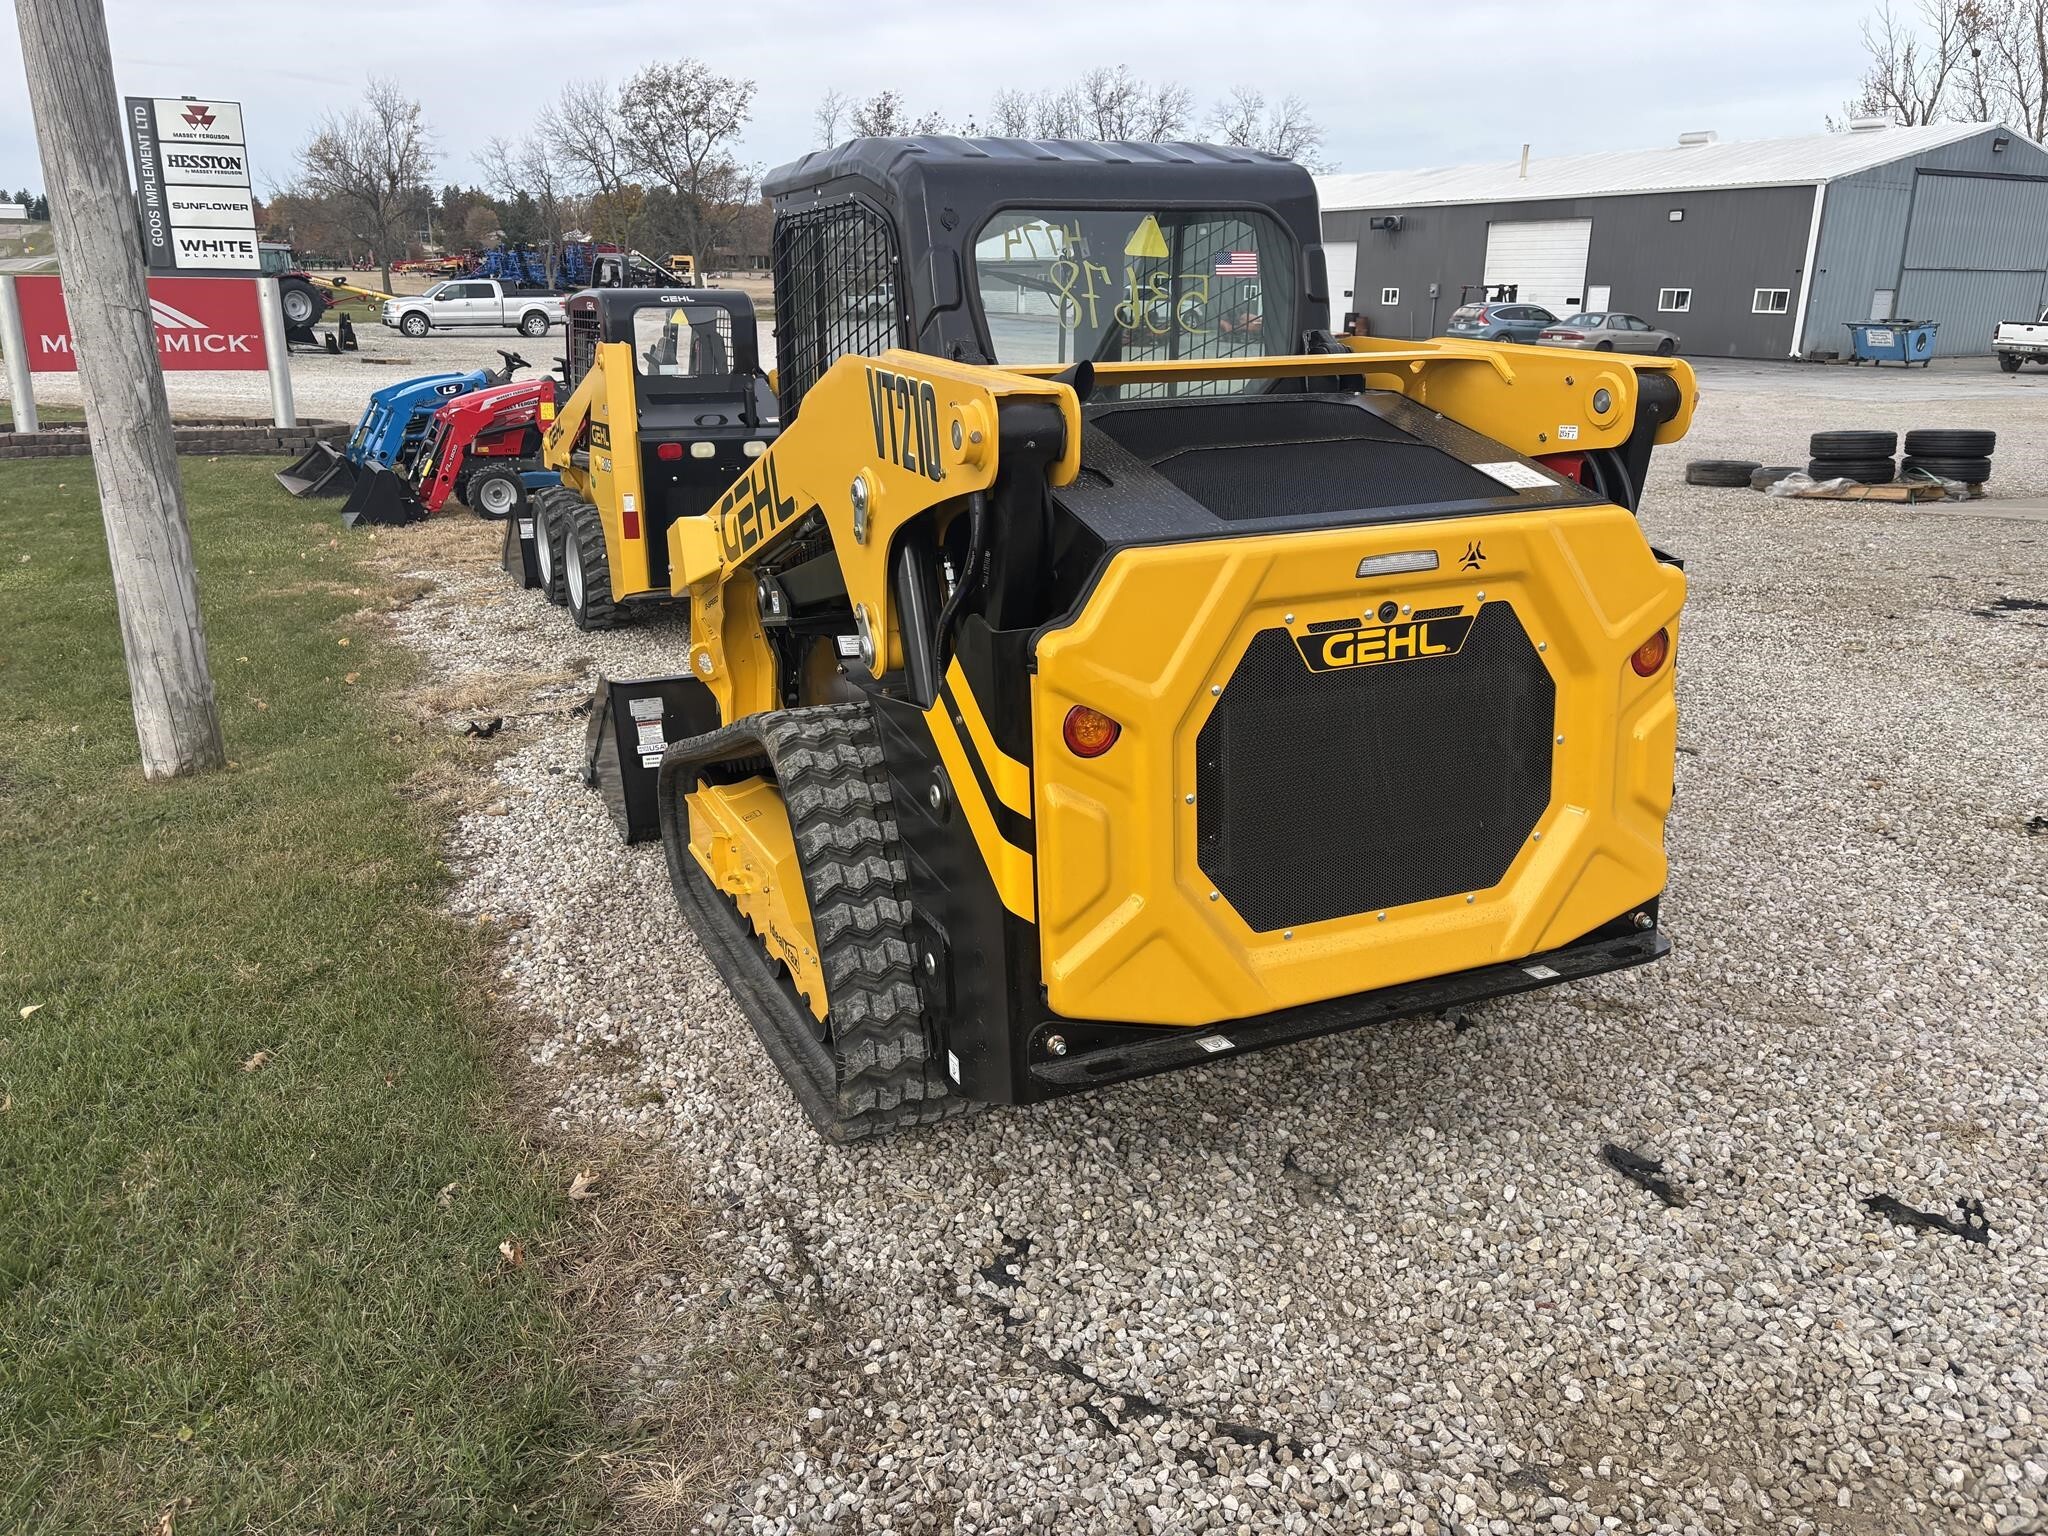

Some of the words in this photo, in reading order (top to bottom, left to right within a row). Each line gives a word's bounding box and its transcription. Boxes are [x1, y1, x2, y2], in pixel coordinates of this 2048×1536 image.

[134, 106, 148, 130] LTD
[138, 133, 159, 207] IMPLEMENT
[167, 154, 242, 170] HESSTON
[172, 202, 249, 211] SUNFLOWER
[149, 211, 164, 247] GOOS
[180, 239, 253, 253] WHITE
[660, 295, 695, 303] GEHL
[443, 385, 457, 395] LS
[591, 424, 610, 447] GEHL
[866, 366, 942, 482] VT210
[721, 450, 796, 562] GEHL
[1322, 623, 1448, 667] GEHL
